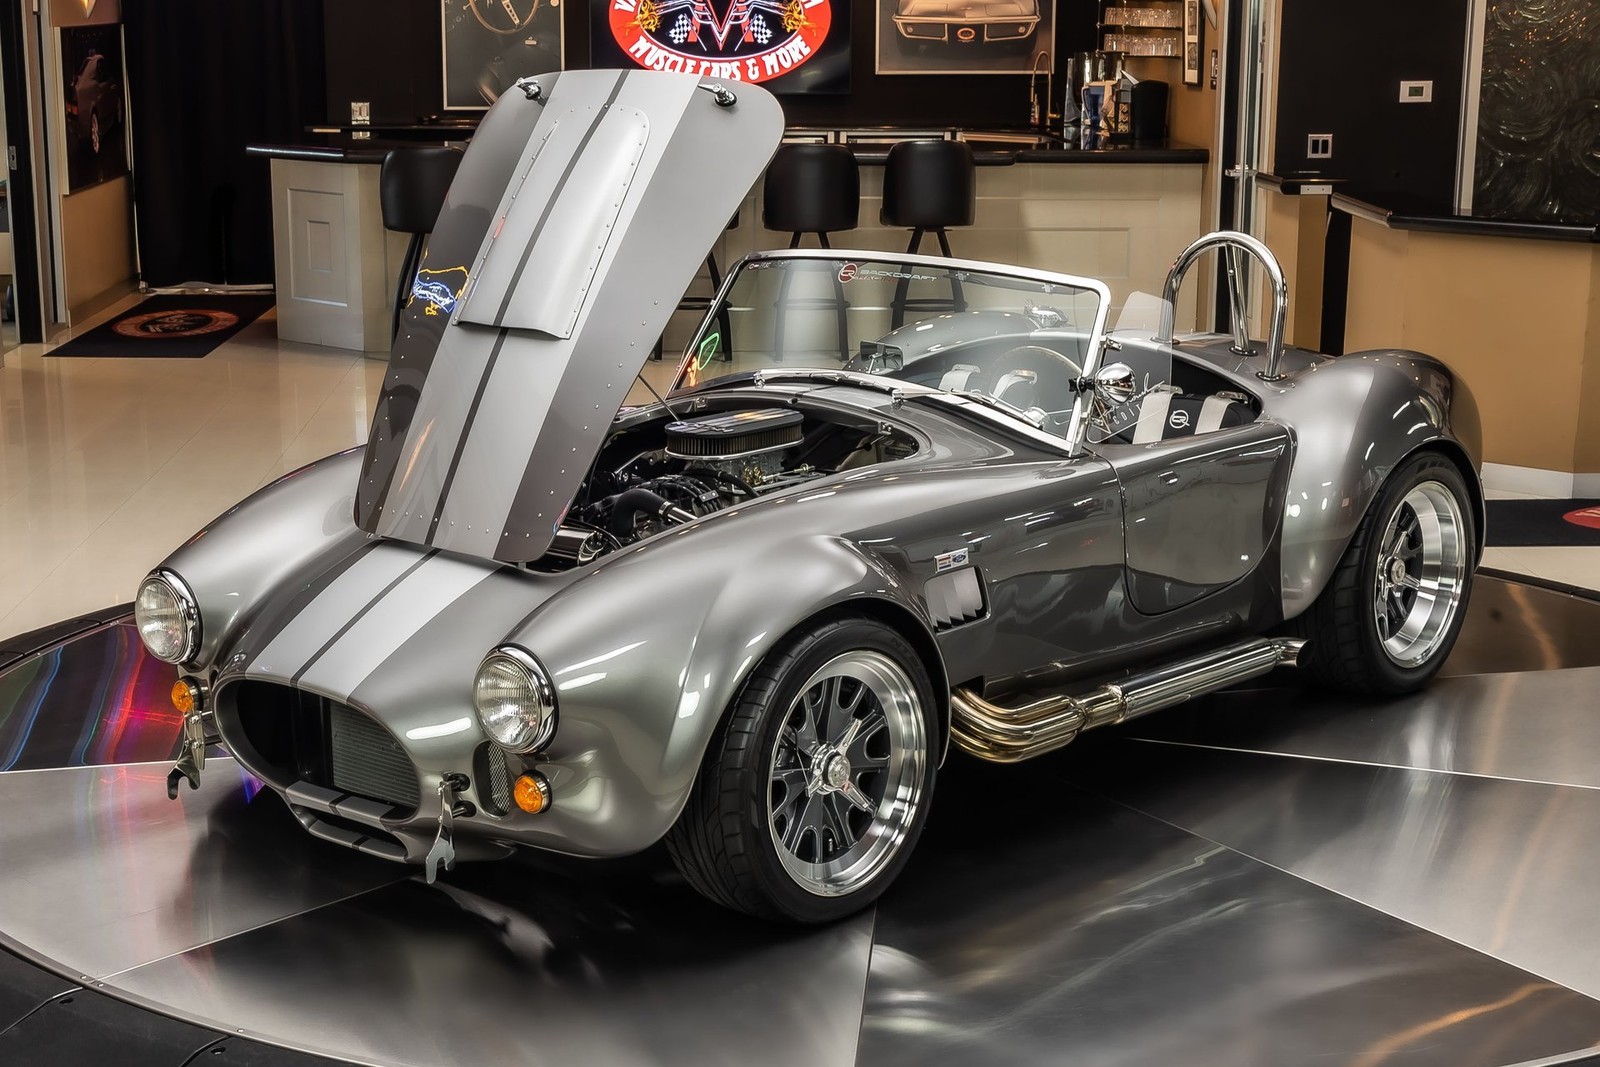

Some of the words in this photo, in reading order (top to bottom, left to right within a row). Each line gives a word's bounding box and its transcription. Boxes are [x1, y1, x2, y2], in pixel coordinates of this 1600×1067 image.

[628, 35, 696, 74] MUSCLE
[699, 61, 742, 81] CARS
[745, 58, 760, 80] &
[761, 34, 811, 76] MORE
[860, 269, 937, 282] BACKDRAFT
